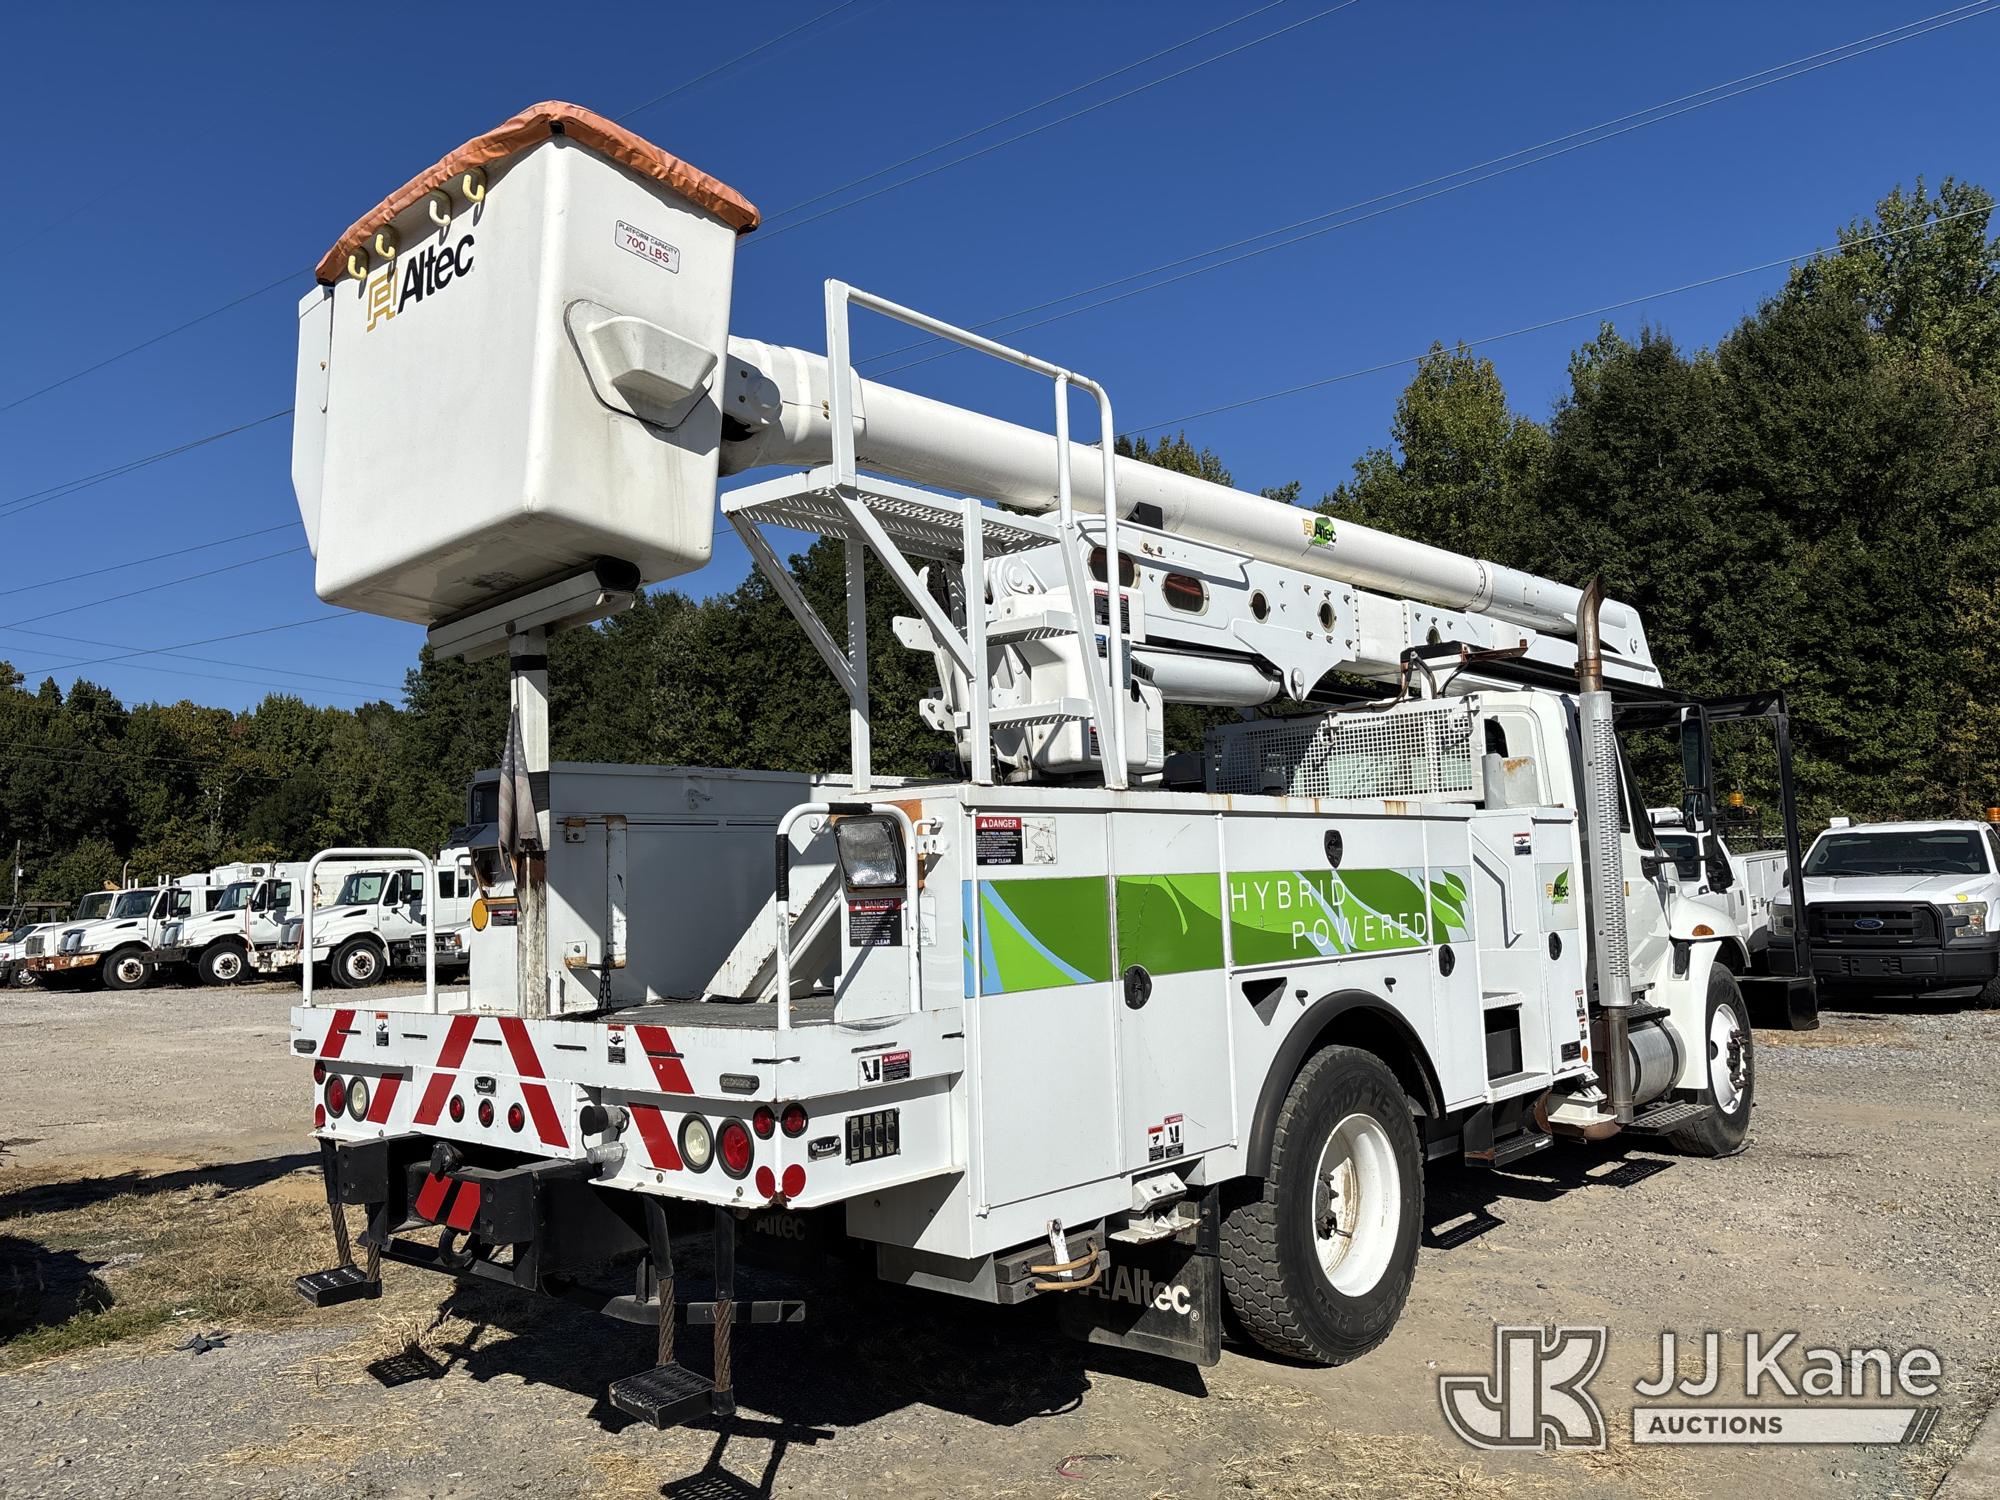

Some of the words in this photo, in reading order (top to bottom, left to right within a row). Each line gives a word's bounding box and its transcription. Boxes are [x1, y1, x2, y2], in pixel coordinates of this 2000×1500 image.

[618, 222, 649, 241] PLATFORM
[650, 238, 678, 255] CAPACITY
[626, 234, 646, 252] 700
[649, 245, 669, 263] LBS
[396, 233, 475, 315] Altec
[1314, 521, 1337, 543] Altec
[988, 819, 1017, 828] DANGER
[864, 899, 894, 909] DANGER
[1230, 879, 1346, 912] HYBRID
[1292, 912, 1426, 950] POWERED
[756, 1215, 806, 1240] Altec
[1111, 1265, 1191, 1315] Altec
